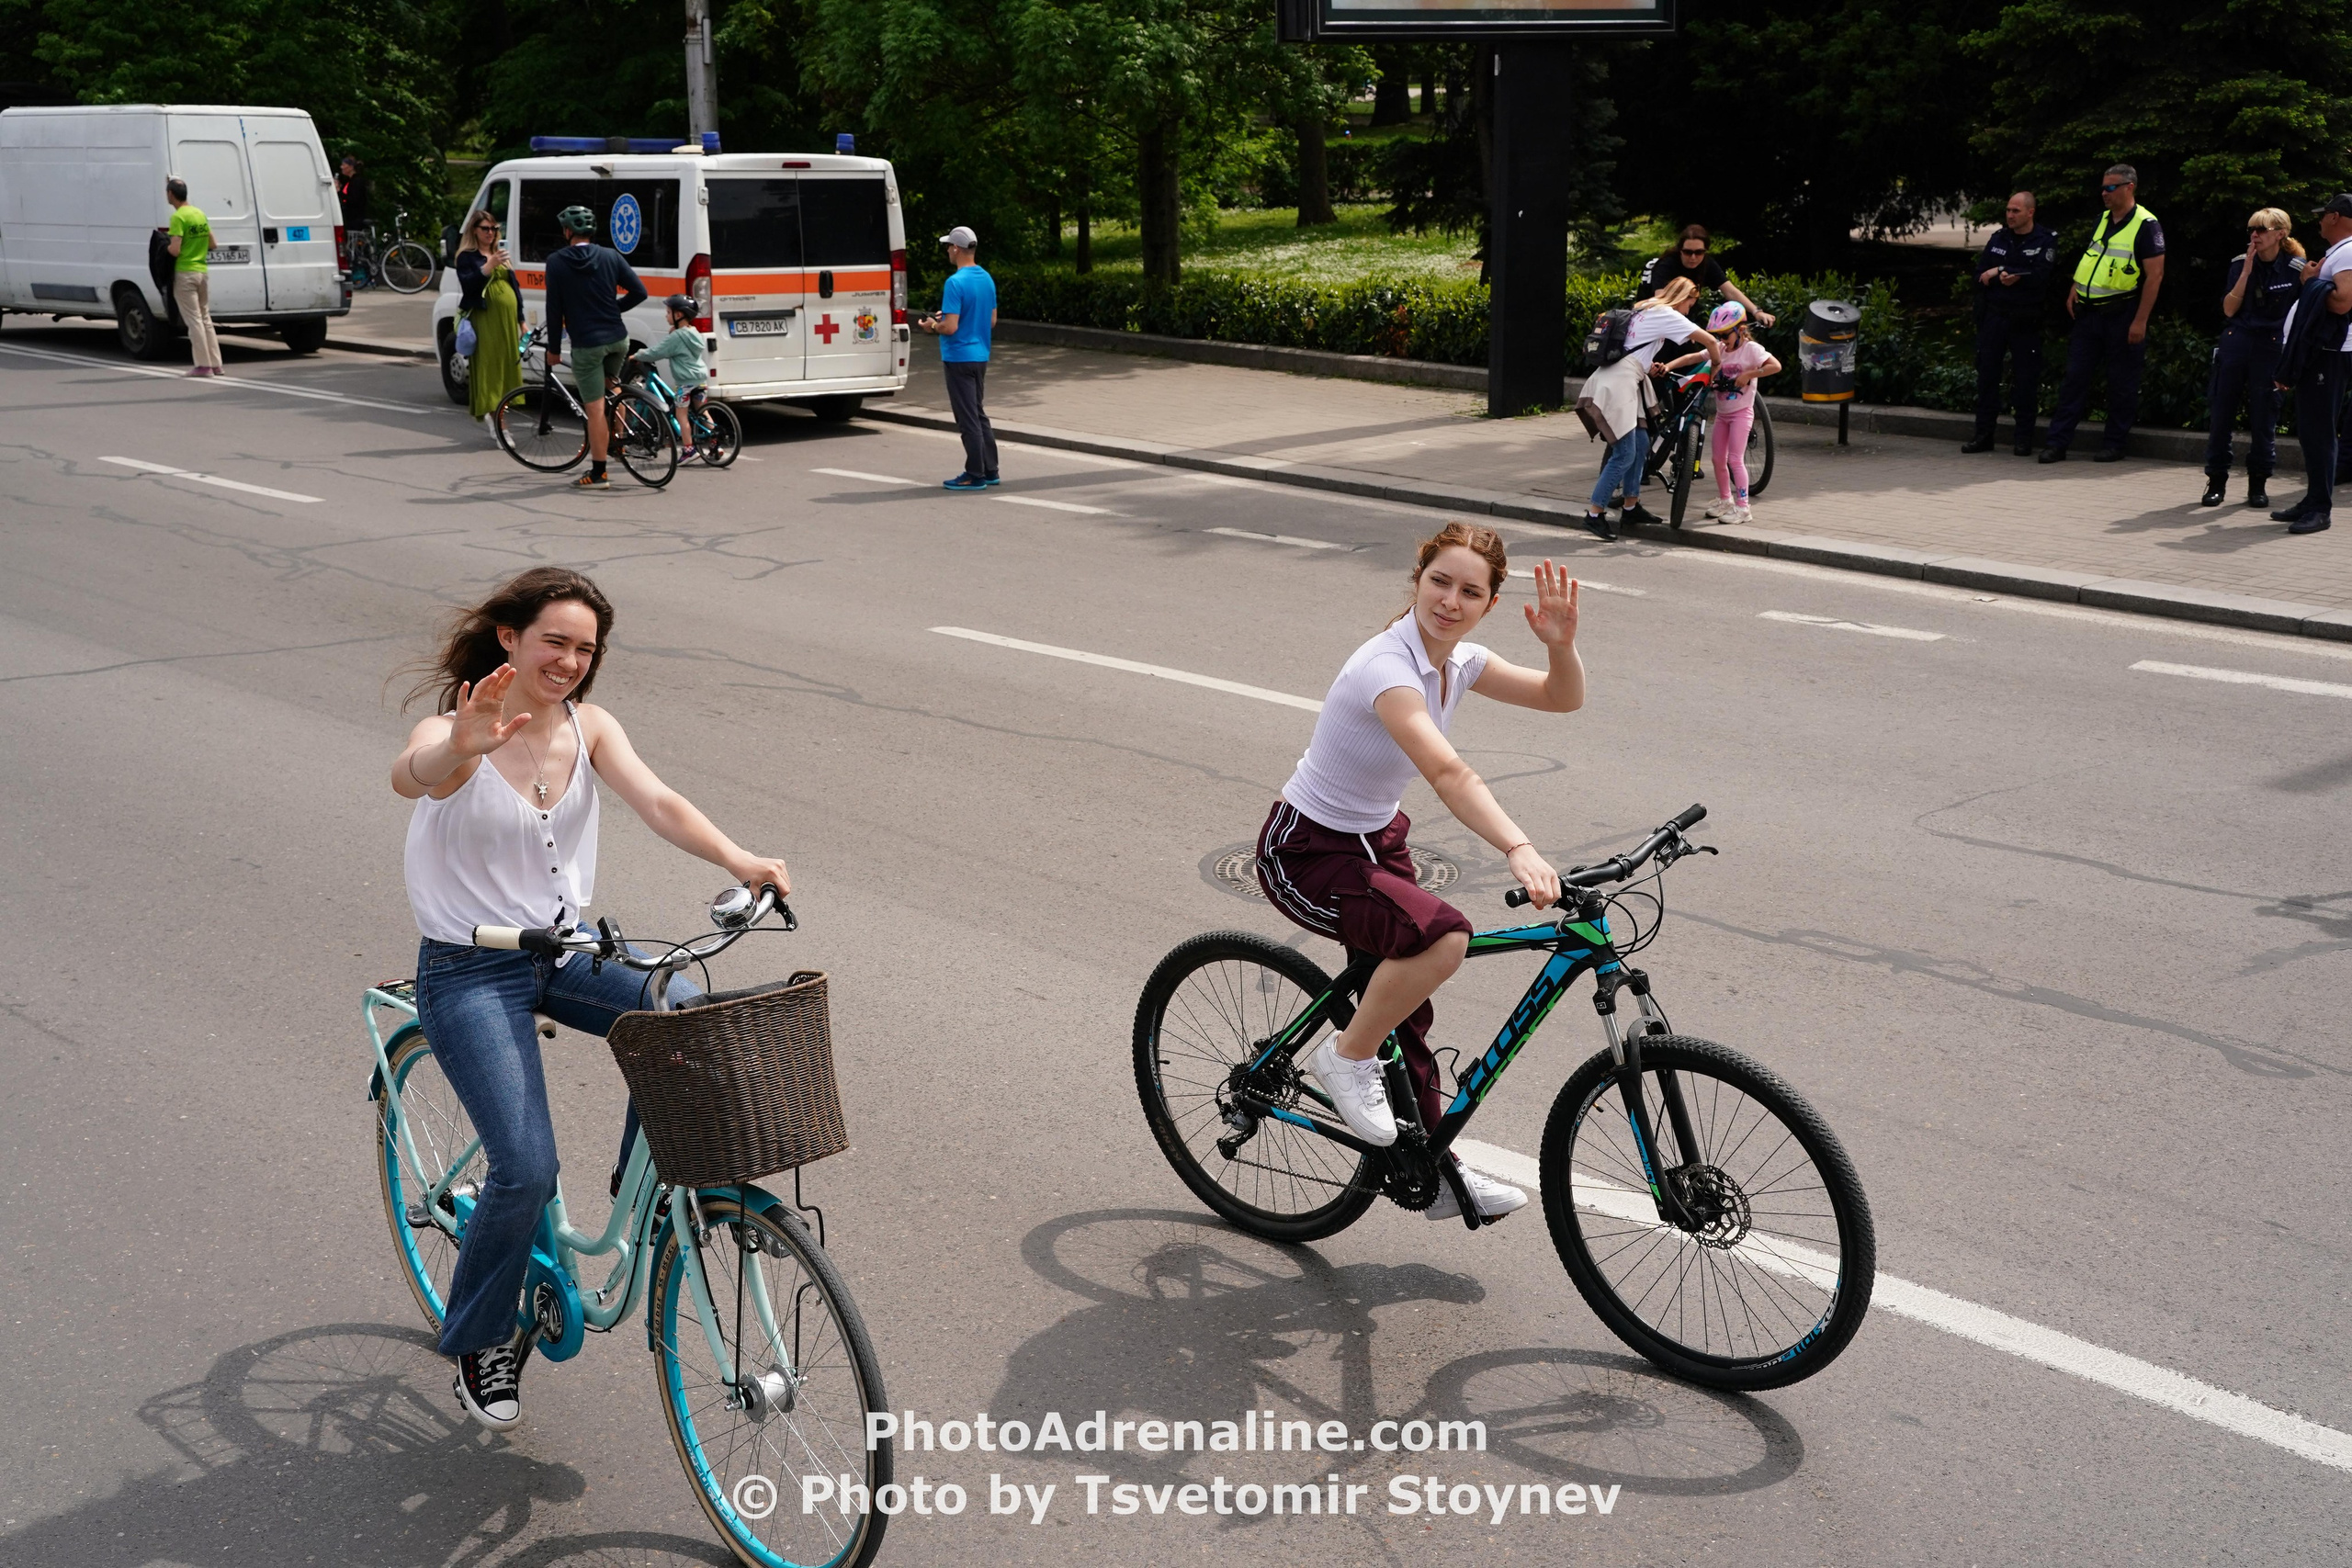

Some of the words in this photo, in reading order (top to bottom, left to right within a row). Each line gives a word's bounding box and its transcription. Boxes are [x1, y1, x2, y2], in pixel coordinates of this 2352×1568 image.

[735, 321, 749, 333] CB
[749, 321, 772, 333] 7820
[774, 321, 786, 332] AK
[1155, 1116, 1182, 1162] KENDA
